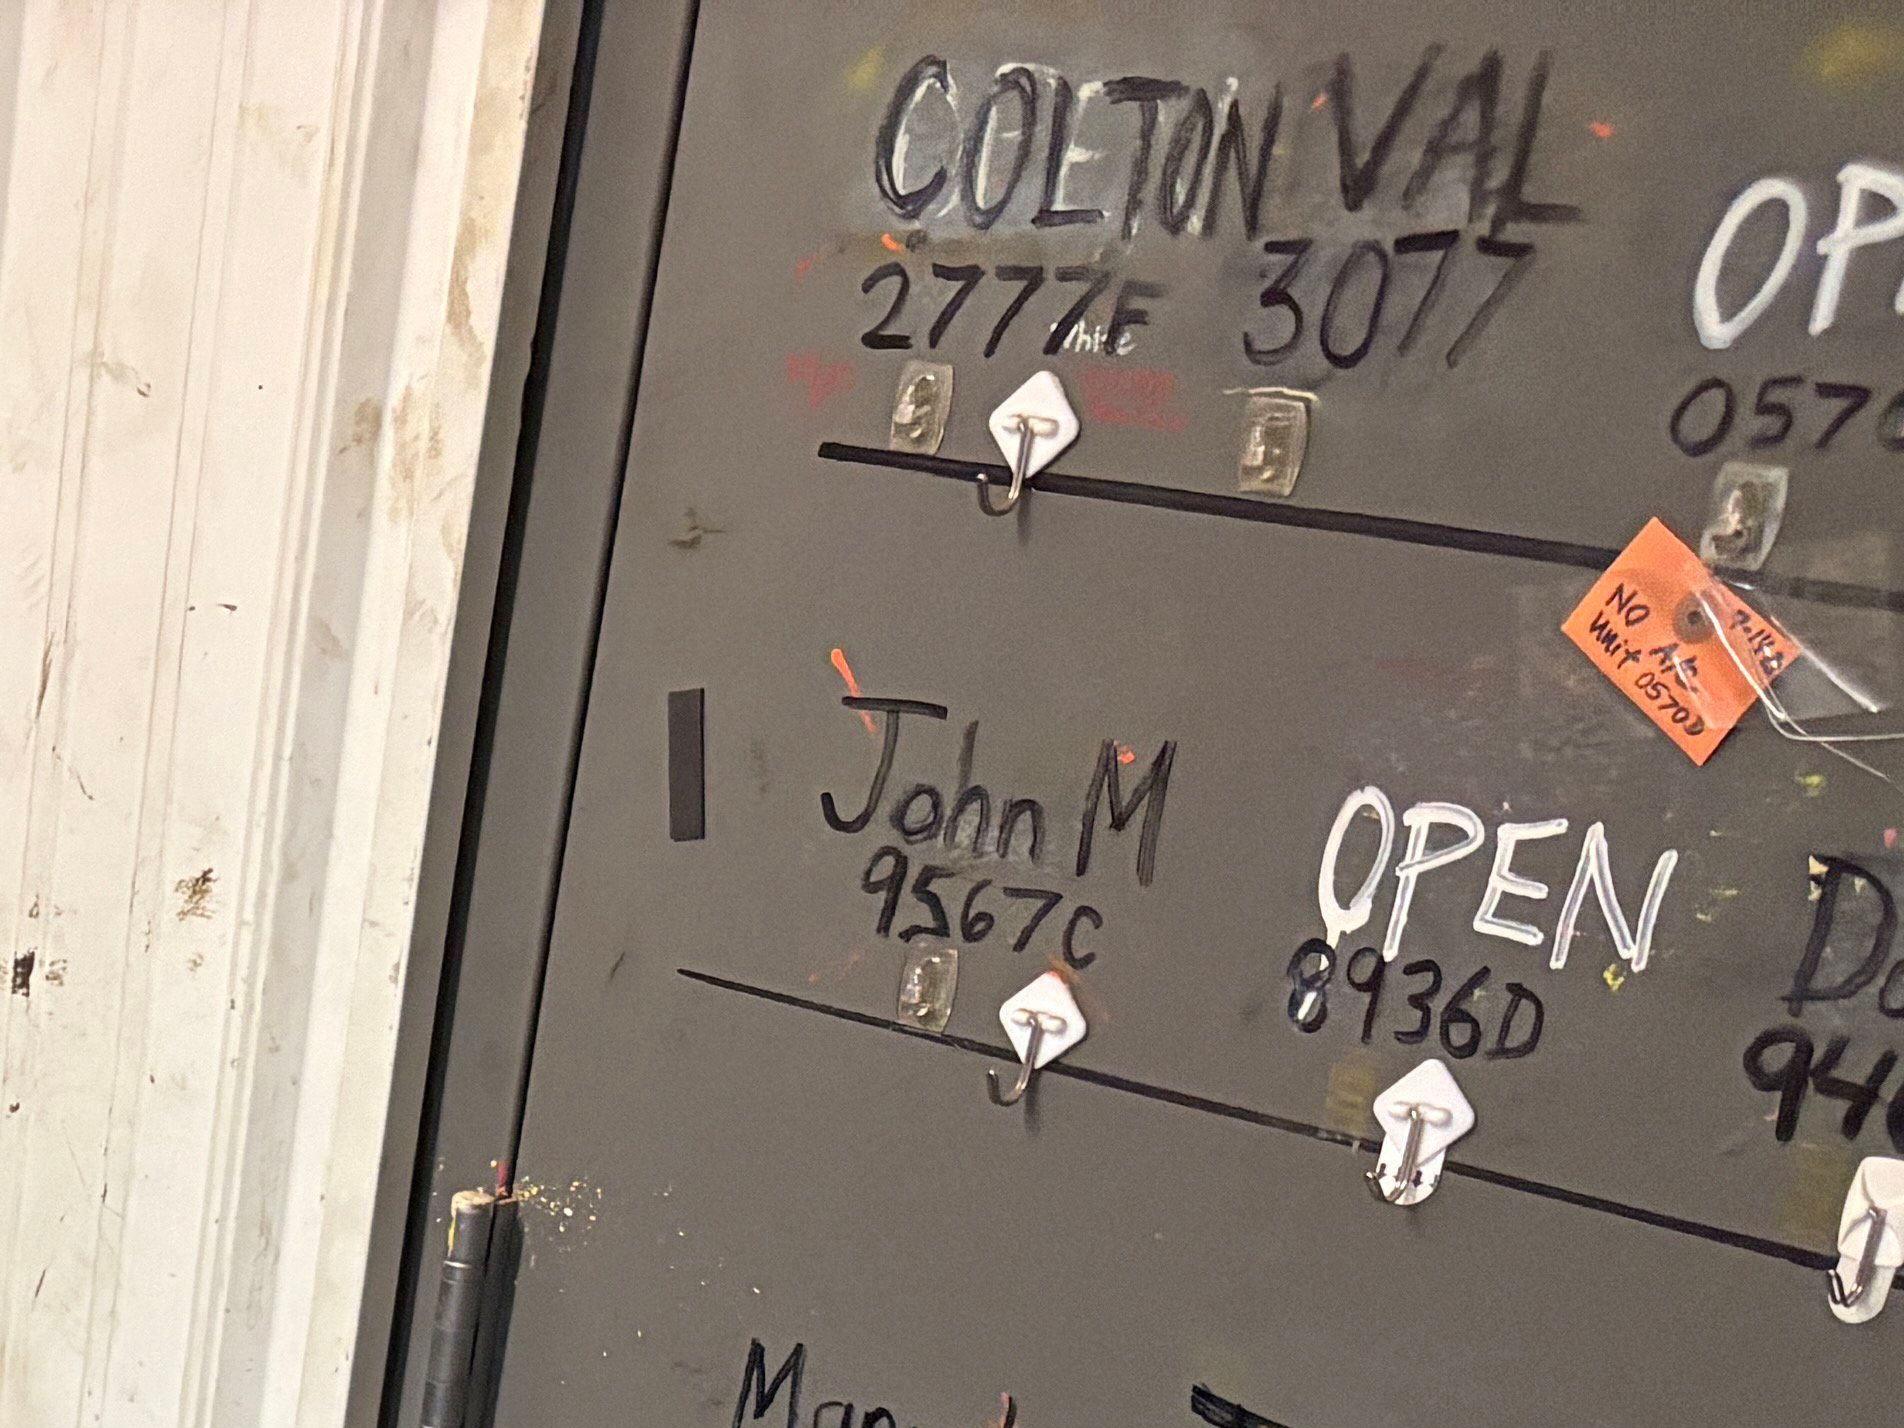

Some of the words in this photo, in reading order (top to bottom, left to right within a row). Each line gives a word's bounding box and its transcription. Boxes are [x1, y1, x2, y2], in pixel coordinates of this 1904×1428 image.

[1325, 40, 1584, 236] VAL
[1244, 230, 1535, 369] 3077
[1605, 583, 1650, 627] NO
[820, 696, 1047, 863] John
[1076, 739, 1178, 888] M
[860, 846, 1104, 970] 9567C
[1318, 785, 1678, 973] OPEN
[1287, 936, 1546, 1061] 8936D
